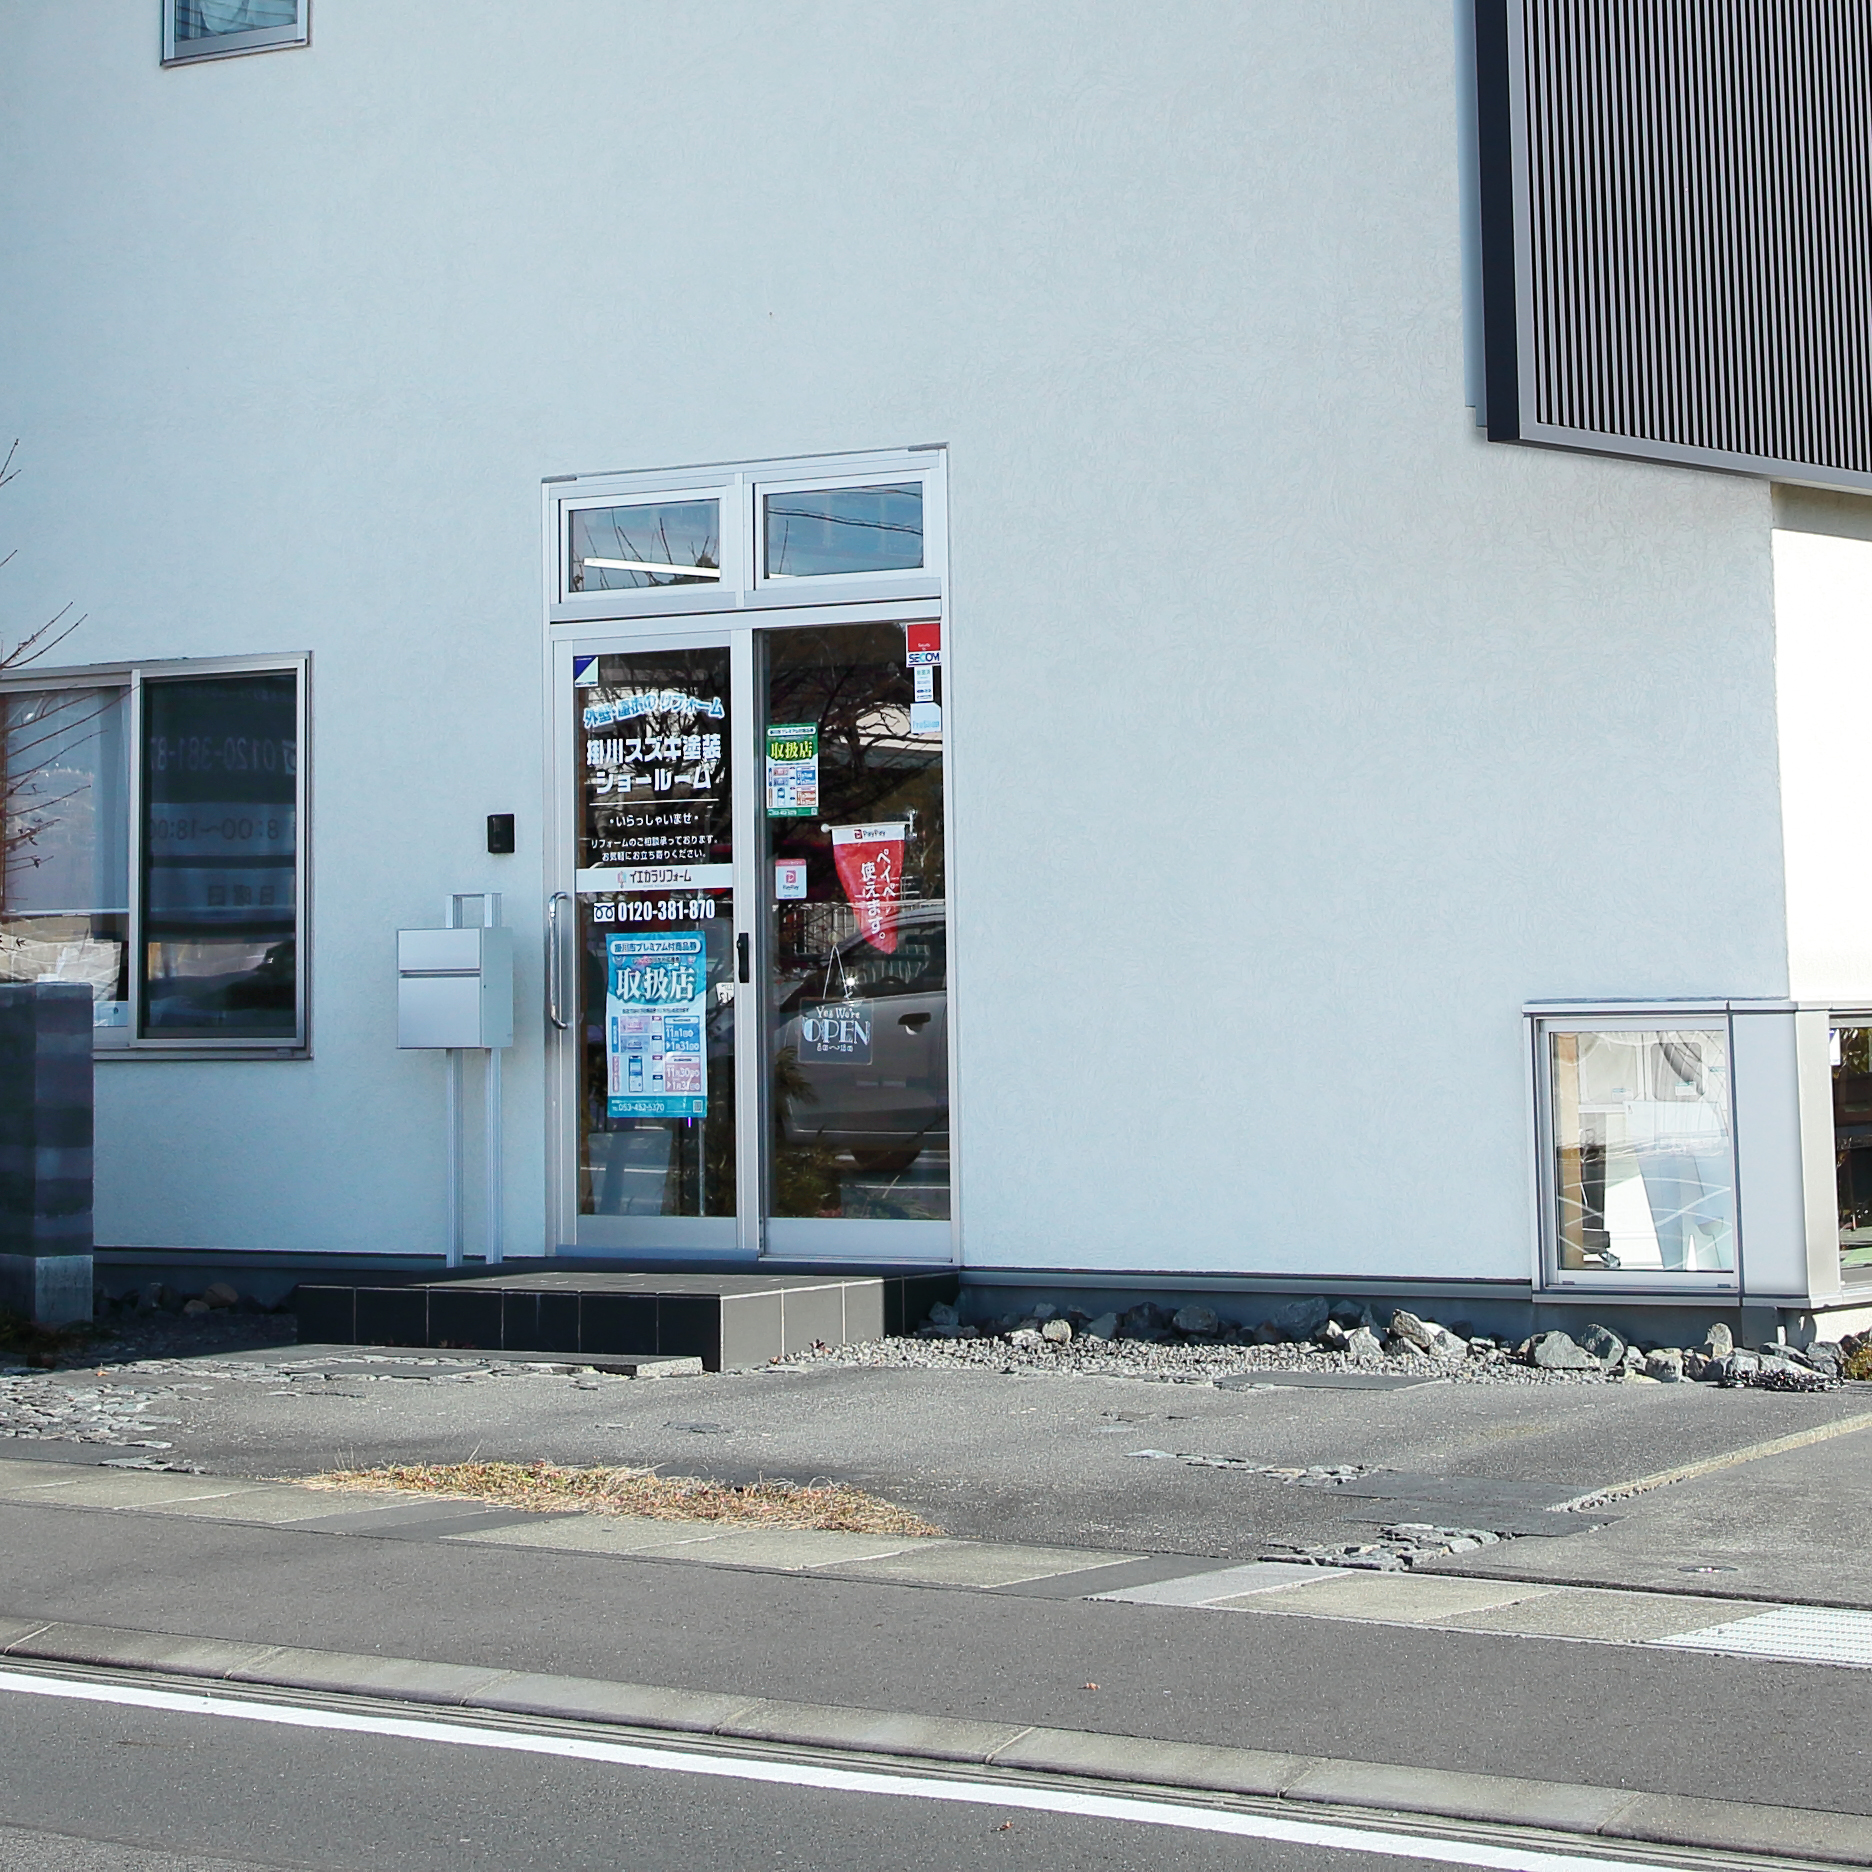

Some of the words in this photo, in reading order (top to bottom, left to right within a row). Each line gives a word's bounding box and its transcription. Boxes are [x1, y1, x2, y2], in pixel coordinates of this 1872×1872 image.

[908, 652, 940, 664] SECOM
[586, 733, 722, 766] 掛川スズキ塗装
[596, 766, 712, 794] ショールーム
[617, 899, 716, 922] 0120-381-870
[616, 966, 695, 1001] 取扱店
[802, 1017, 871, 1046] OPEN
